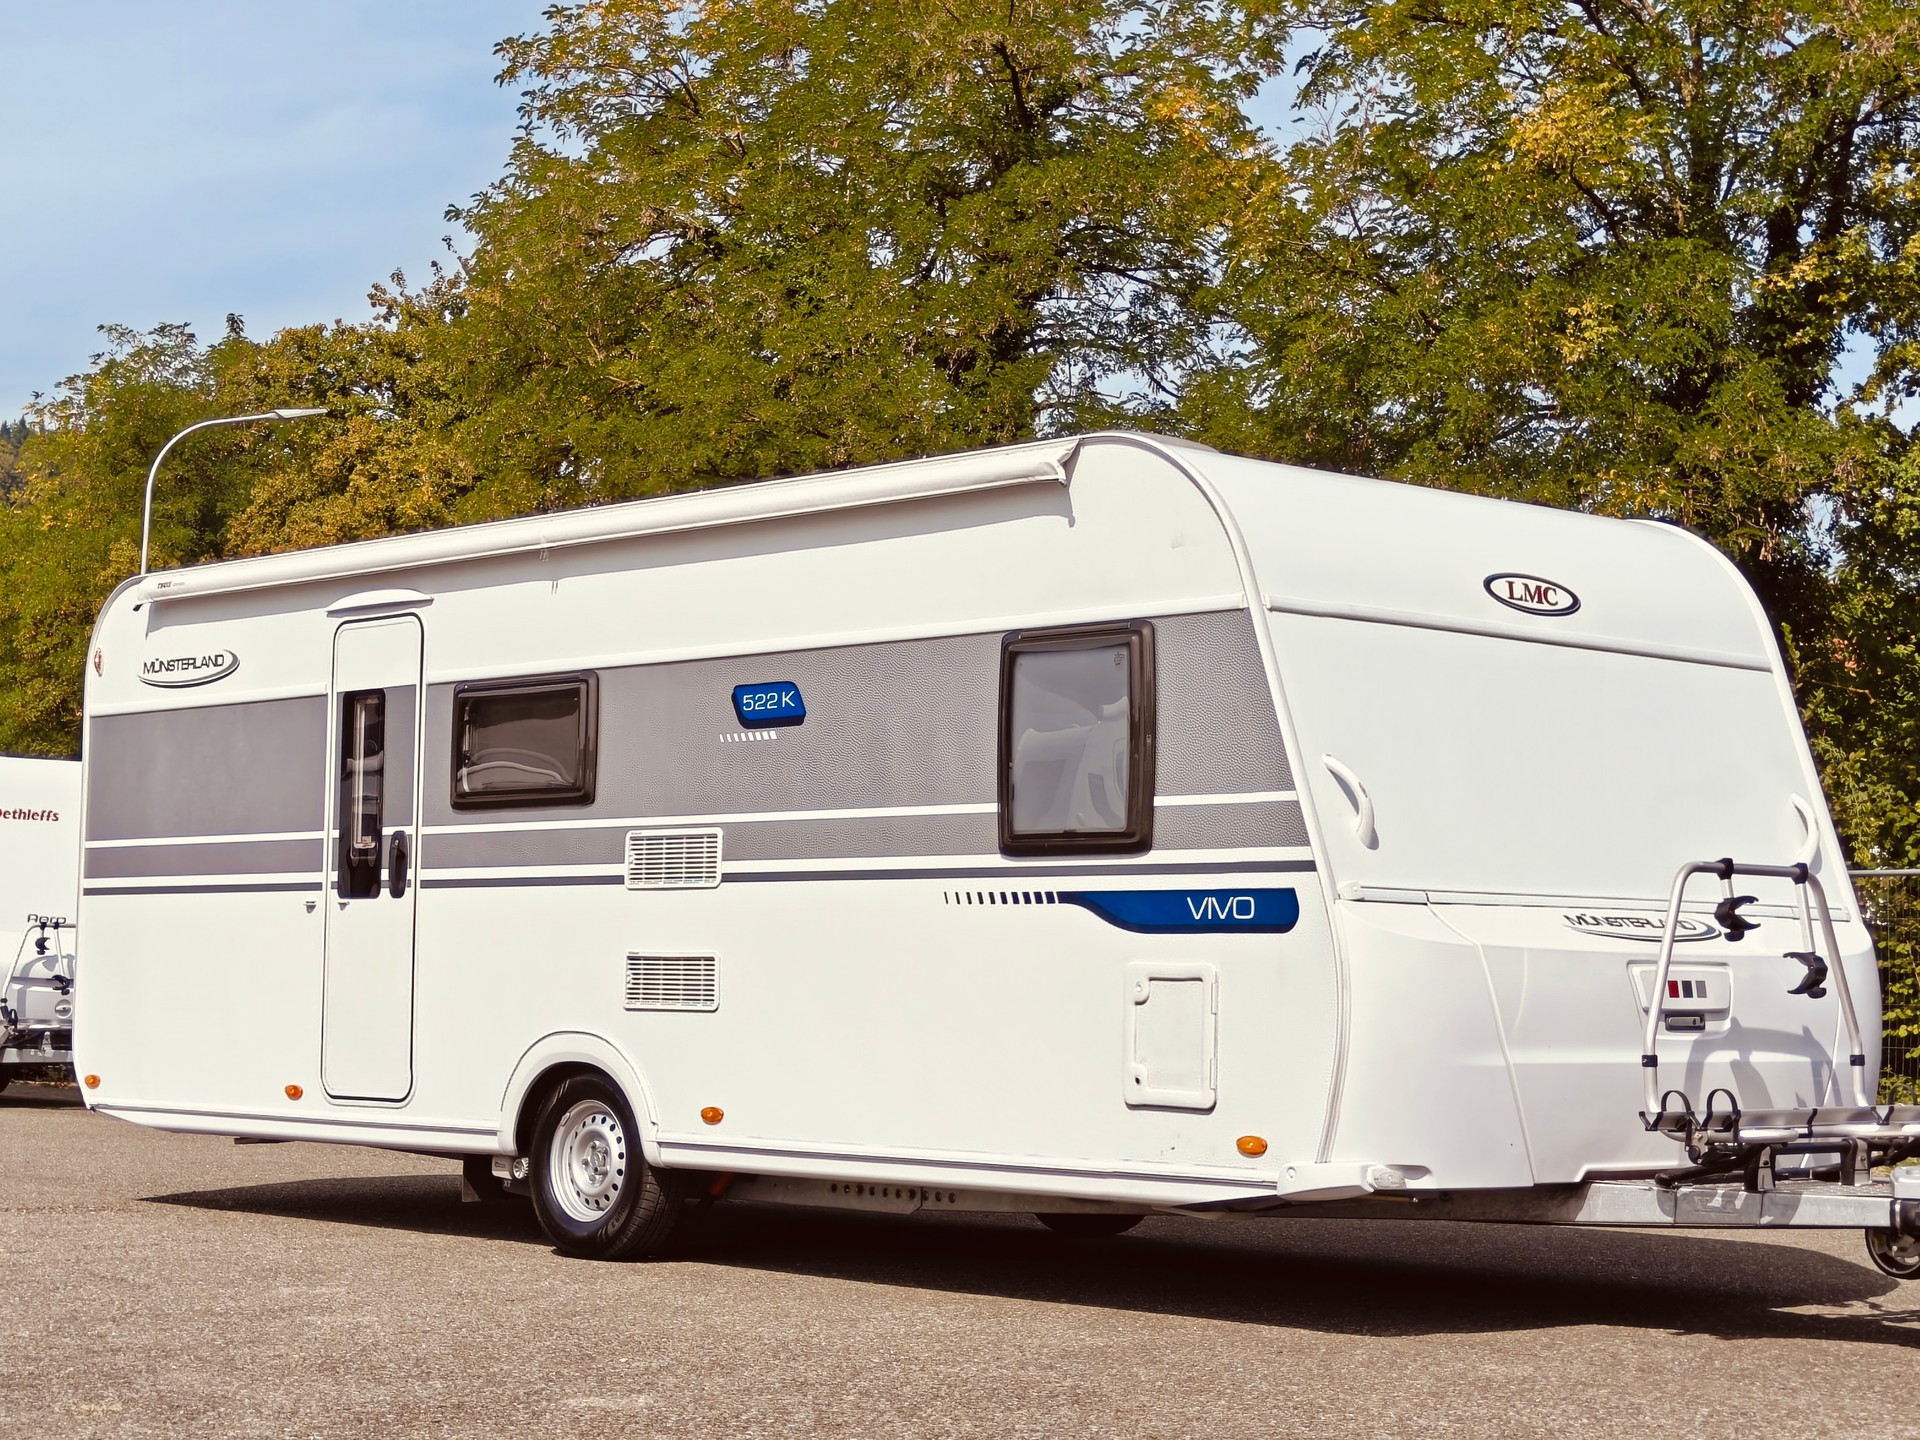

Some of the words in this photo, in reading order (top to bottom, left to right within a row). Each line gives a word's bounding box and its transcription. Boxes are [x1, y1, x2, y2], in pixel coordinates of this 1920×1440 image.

[1505, 580, 1559, 607] LMC
[142, 654, 225, 675] MÜNSTERLAND
[743, 693, 778, 711] 522
[782, 691, 796, 708] K
[0, 808, 60, 822] ethleffs
[1186, 896, 1255, 920] VIVO
[1563, 913, 1697, 930] MÜNSTERLD
